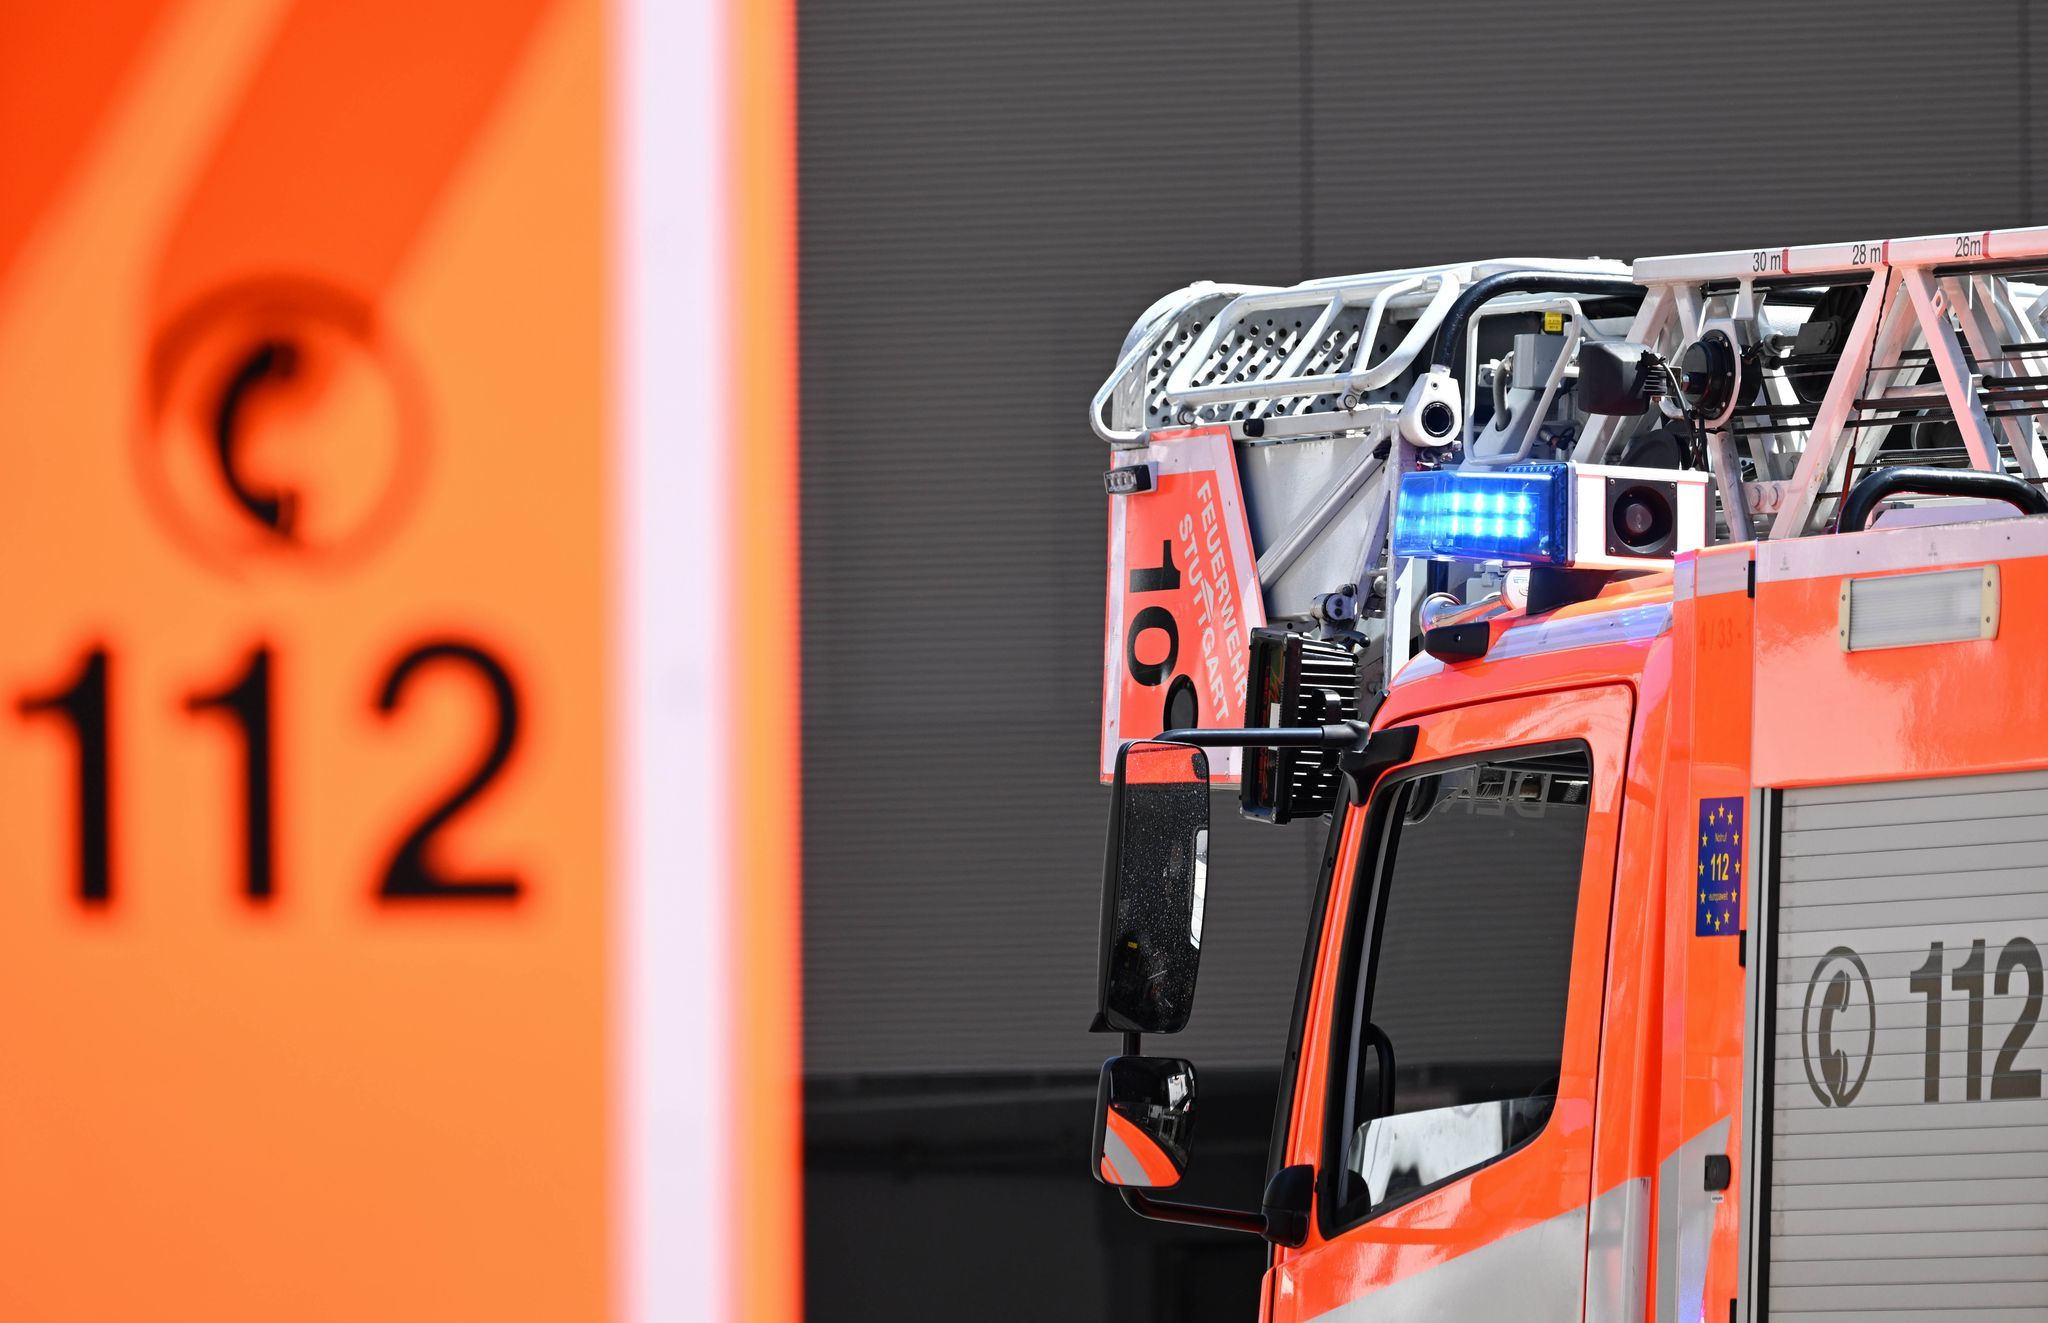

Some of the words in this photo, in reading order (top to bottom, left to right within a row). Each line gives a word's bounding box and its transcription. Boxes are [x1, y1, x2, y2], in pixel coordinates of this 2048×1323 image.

[1752, 251, 1767, 272] 30
[1770, 254, 1781, 271] m
[1852, 243, 1867, 266] 28
[1869, 247, 1881, 263] m
[1954, 236, 1981, 258] 26m
[1179, 513, 1229, 721] STUTTGART
[1197, 480, 1248, 708] FEUERWEHR
[17, 638, 523, 903] 112
[1710, 853, 1729, 881] 112
[1909, 936, 2044, 1103] 112
